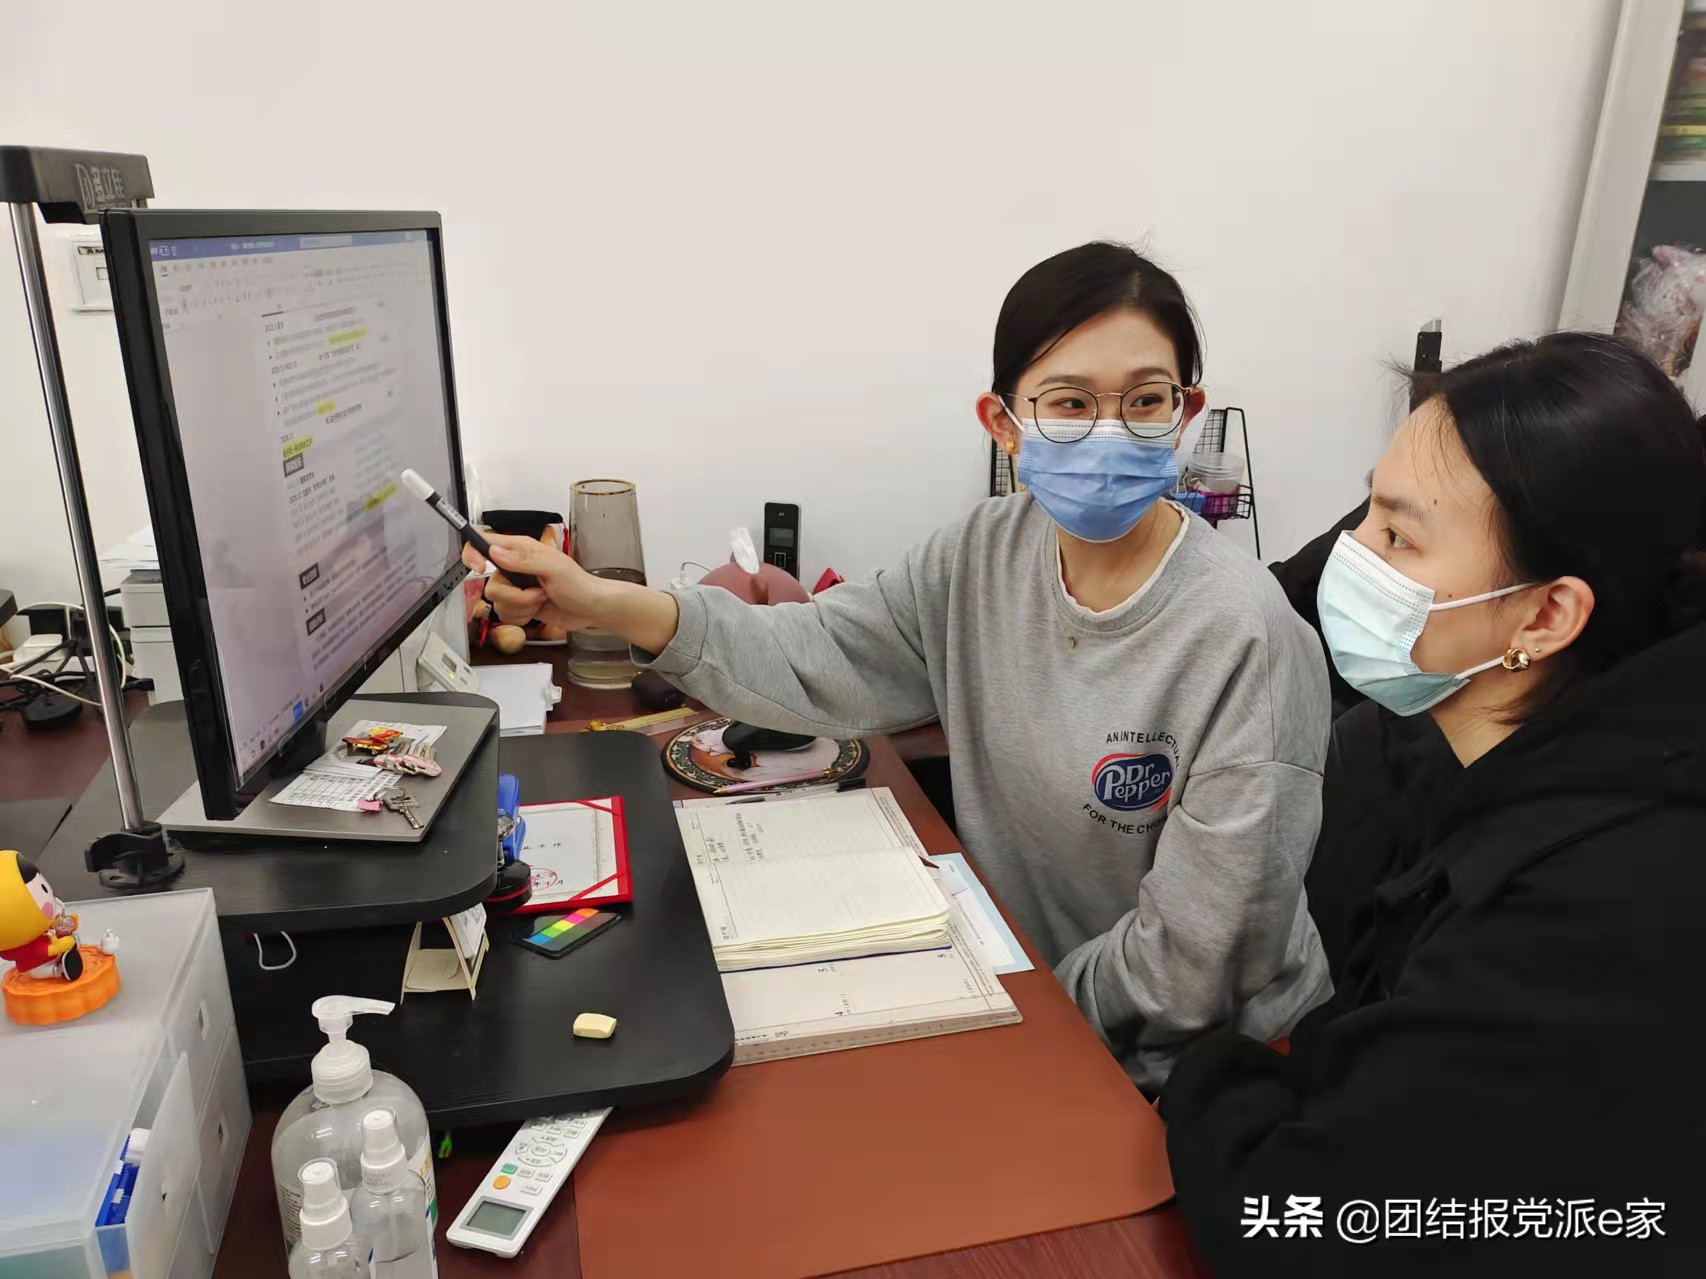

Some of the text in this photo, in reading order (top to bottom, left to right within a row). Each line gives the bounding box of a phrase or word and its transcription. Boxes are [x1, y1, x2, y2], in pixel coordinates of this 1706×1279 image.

[1106, 732, 1118, 744] AN
[1083, 803, 1167, 834] FOR THE CHO
